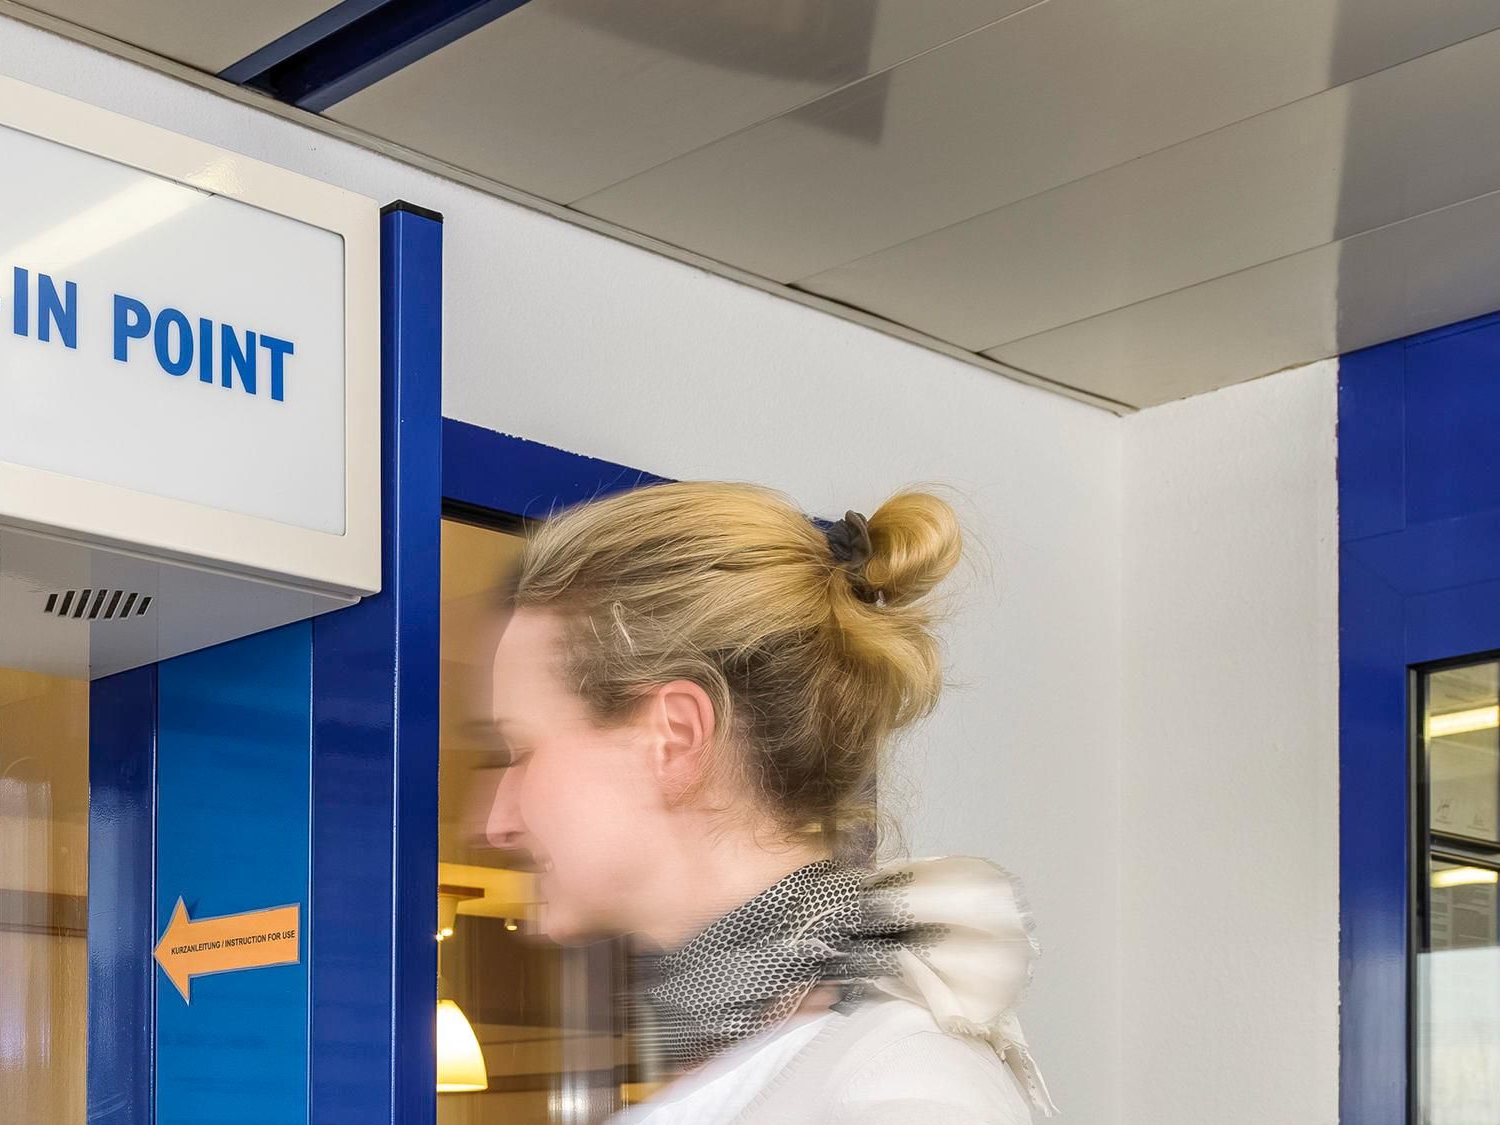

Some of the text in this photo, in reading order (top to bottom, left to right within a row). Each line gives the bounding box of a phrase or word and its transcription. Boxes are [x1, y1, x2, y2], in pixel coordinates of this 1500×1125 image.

[113, 294, 294, 402] POINT
[171, 929, 296, 954] KURZANLEITUNG INSTRUCTION FOR USE
